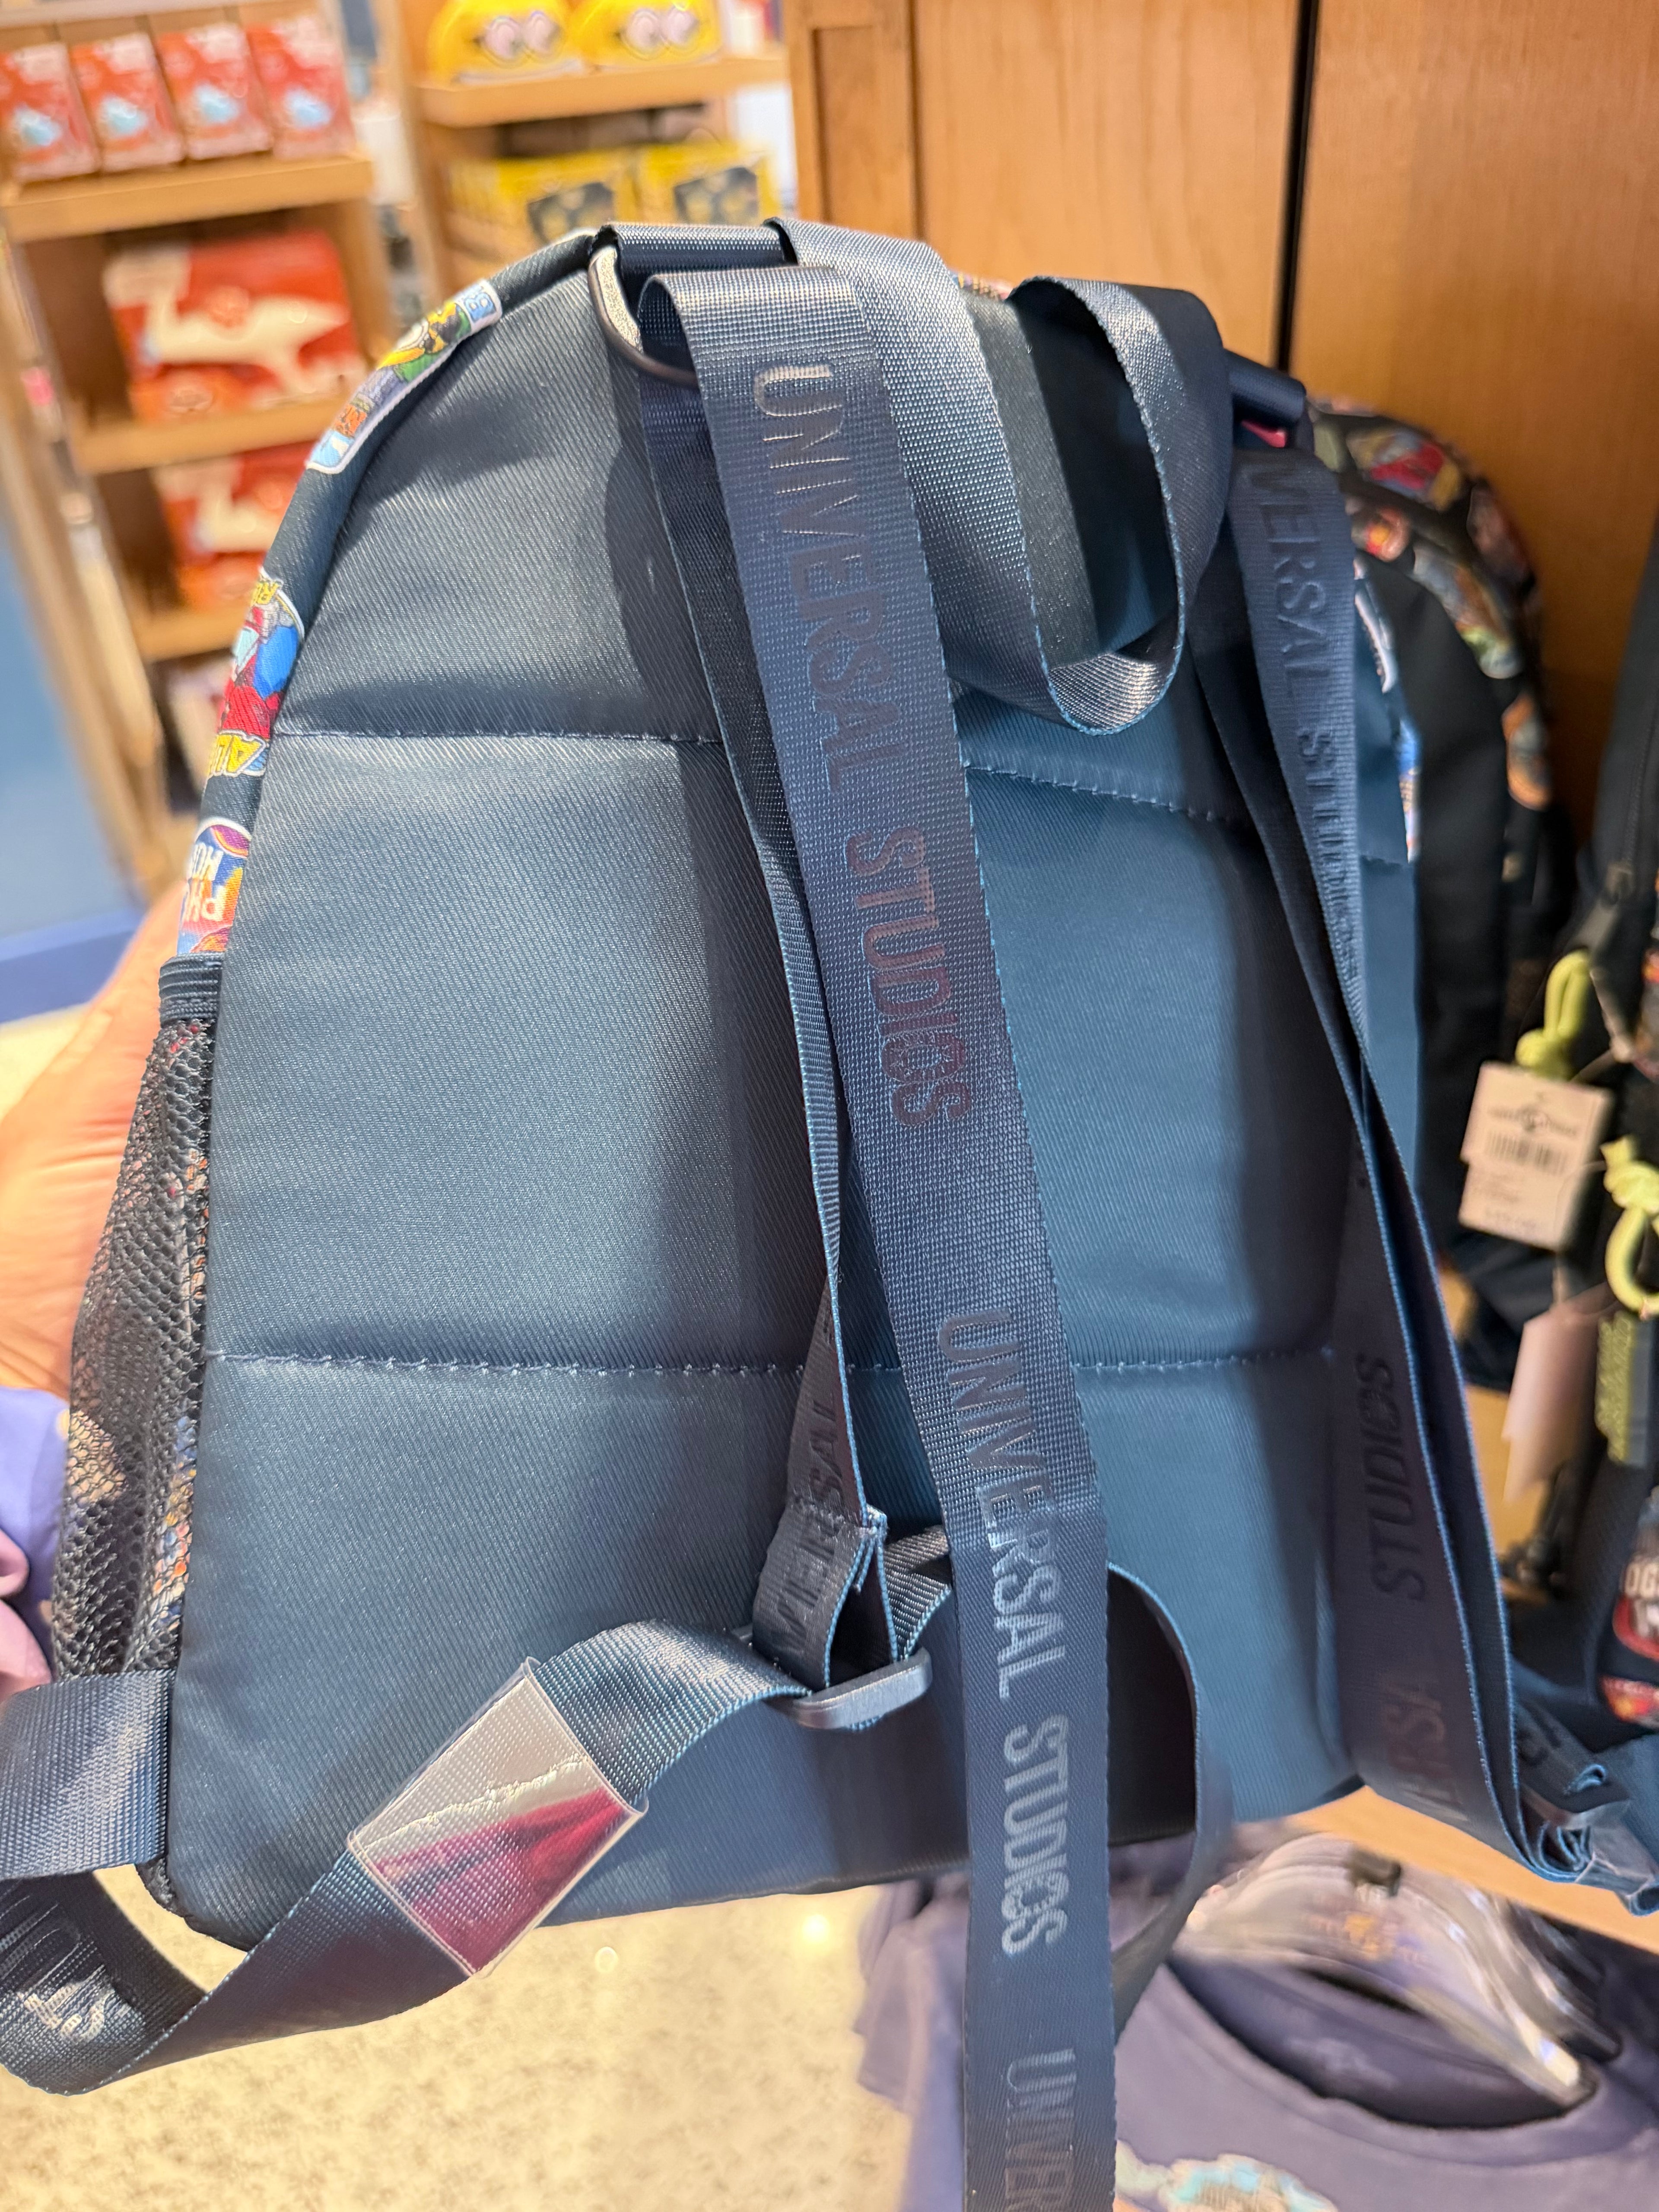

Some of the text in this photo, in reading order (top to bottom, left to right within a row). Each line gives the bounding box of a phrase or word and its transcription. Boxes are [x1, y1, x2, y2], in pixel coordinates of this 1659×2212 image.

[753, 364, 972, 1125] UNIVERSAL STUDIOS
[938, 1307, 1069, 1955] UNIVERSAL STUDIOS
[1354, 1352, 1427, 1601] STUDIOS
